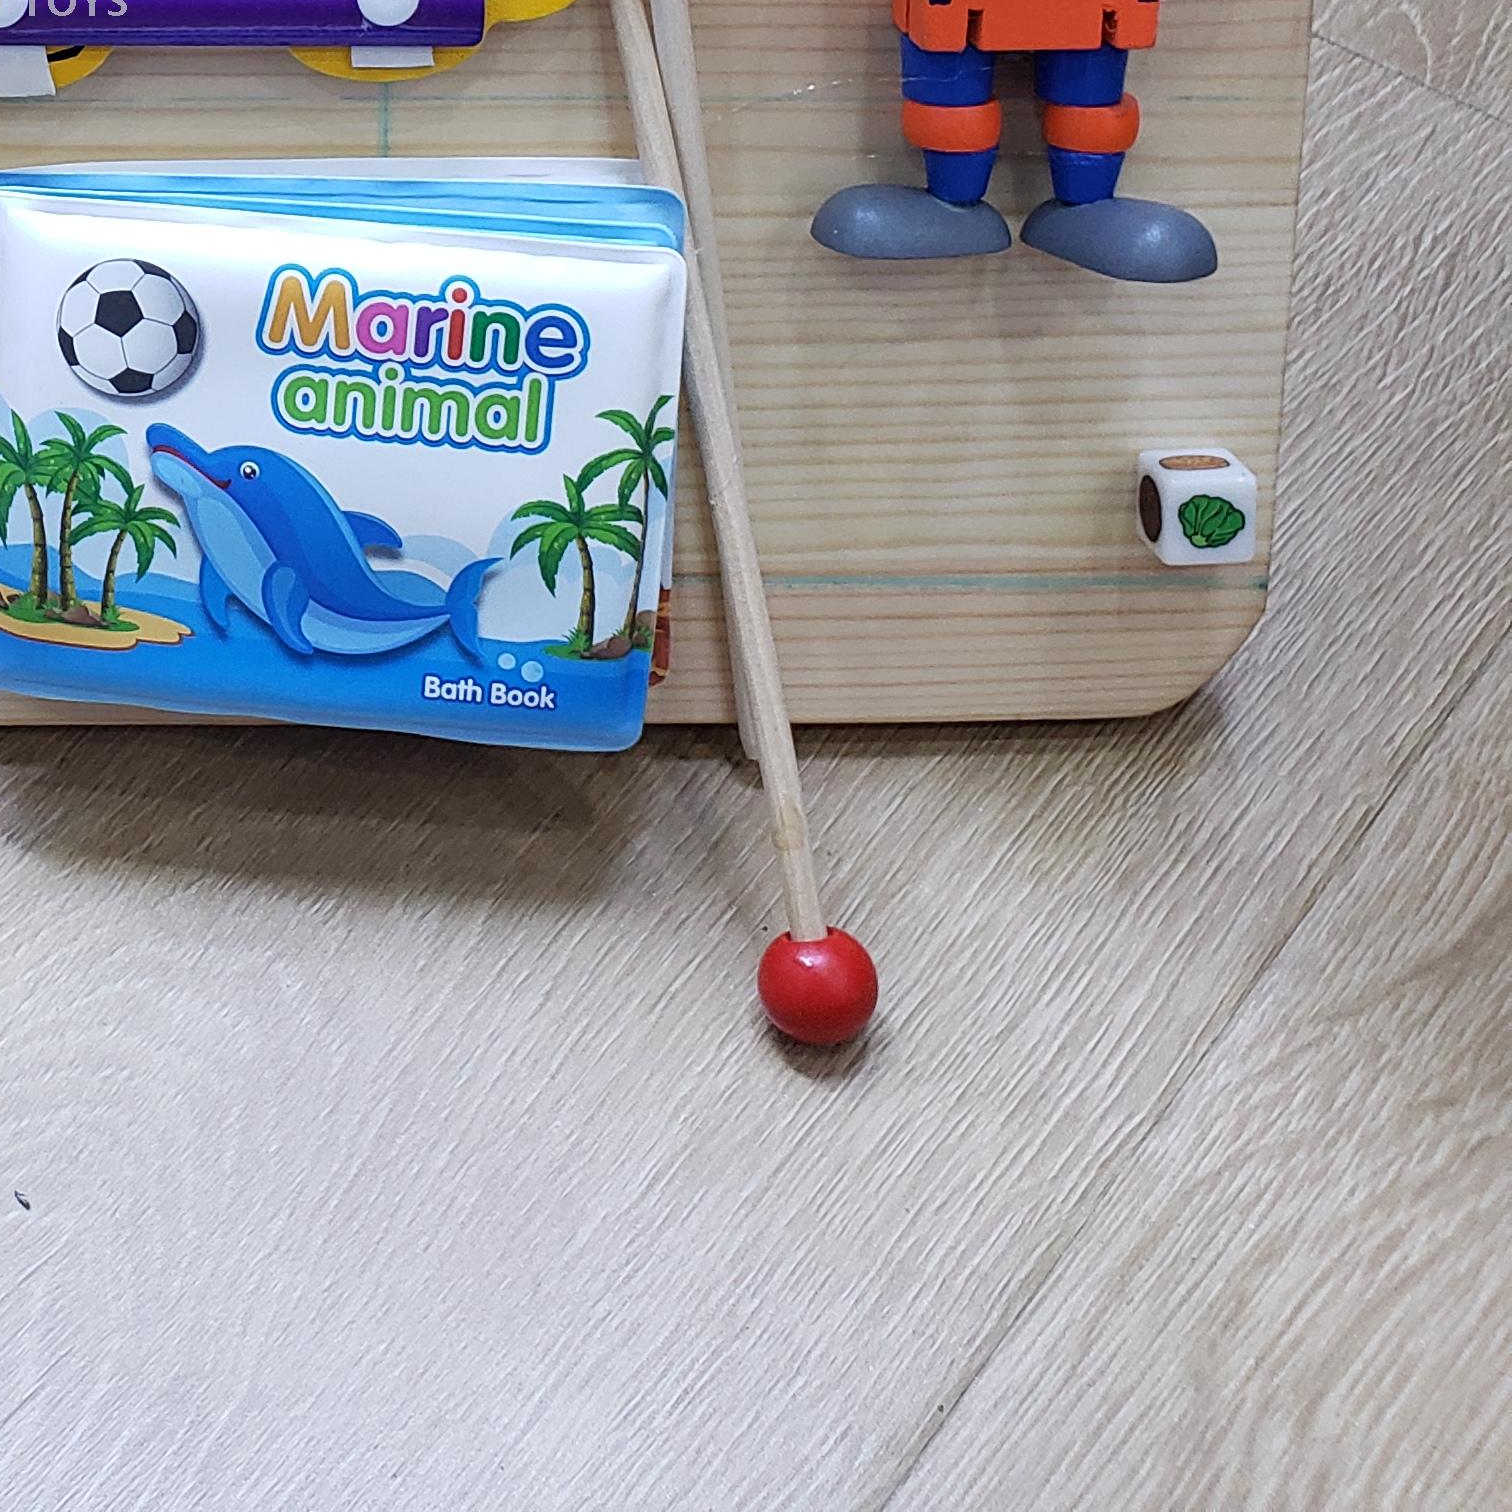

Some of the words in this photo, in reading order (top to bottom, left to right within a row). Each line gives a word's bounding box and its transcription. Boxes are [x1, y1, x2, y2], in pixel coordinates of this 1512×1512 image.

[265, 272, 582, 371] Marine
[281, 365, 544, 445] animal
[422, 674, 483, 703] Bath
[489, 682, 556, 710] Book
